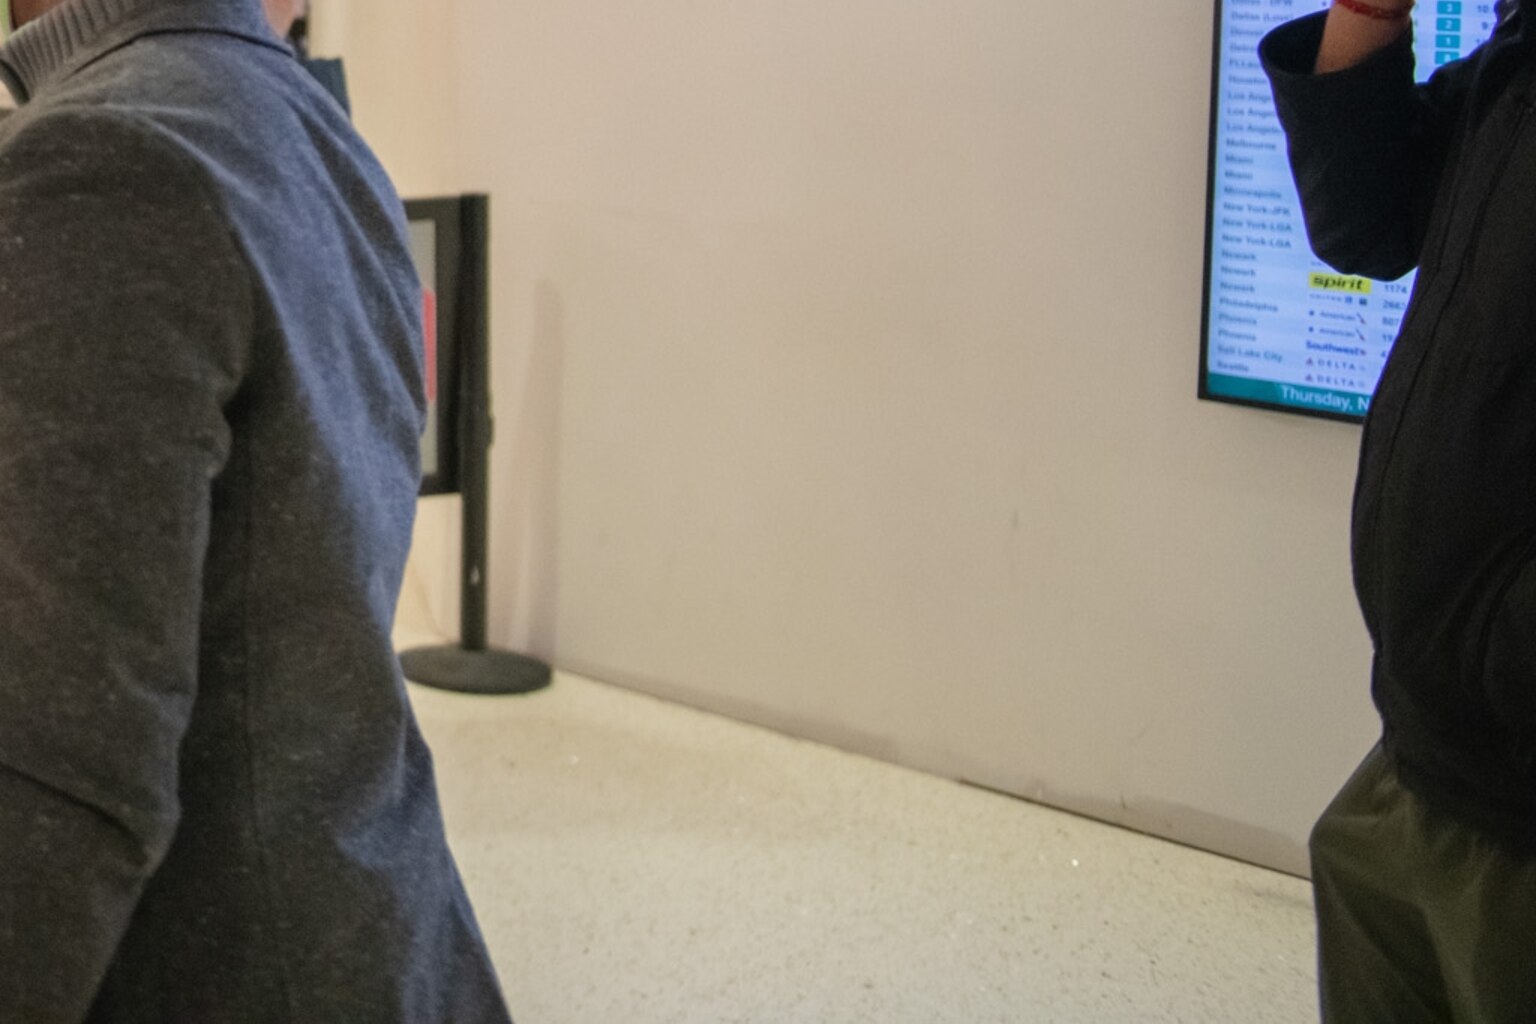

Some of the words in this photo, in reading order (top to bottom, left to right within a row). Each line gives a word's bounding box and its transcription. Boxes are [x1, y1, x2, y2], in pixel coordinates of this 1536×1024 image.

[1313, 274, 1363, 293] spirit
[1305, 341, 1359, 356] Southwest
[1317, 358, 1356, 371] DELTA
[1316, 375, 1356, 388] DELTA
[1280, 386, 1353, 412] Thursday,
